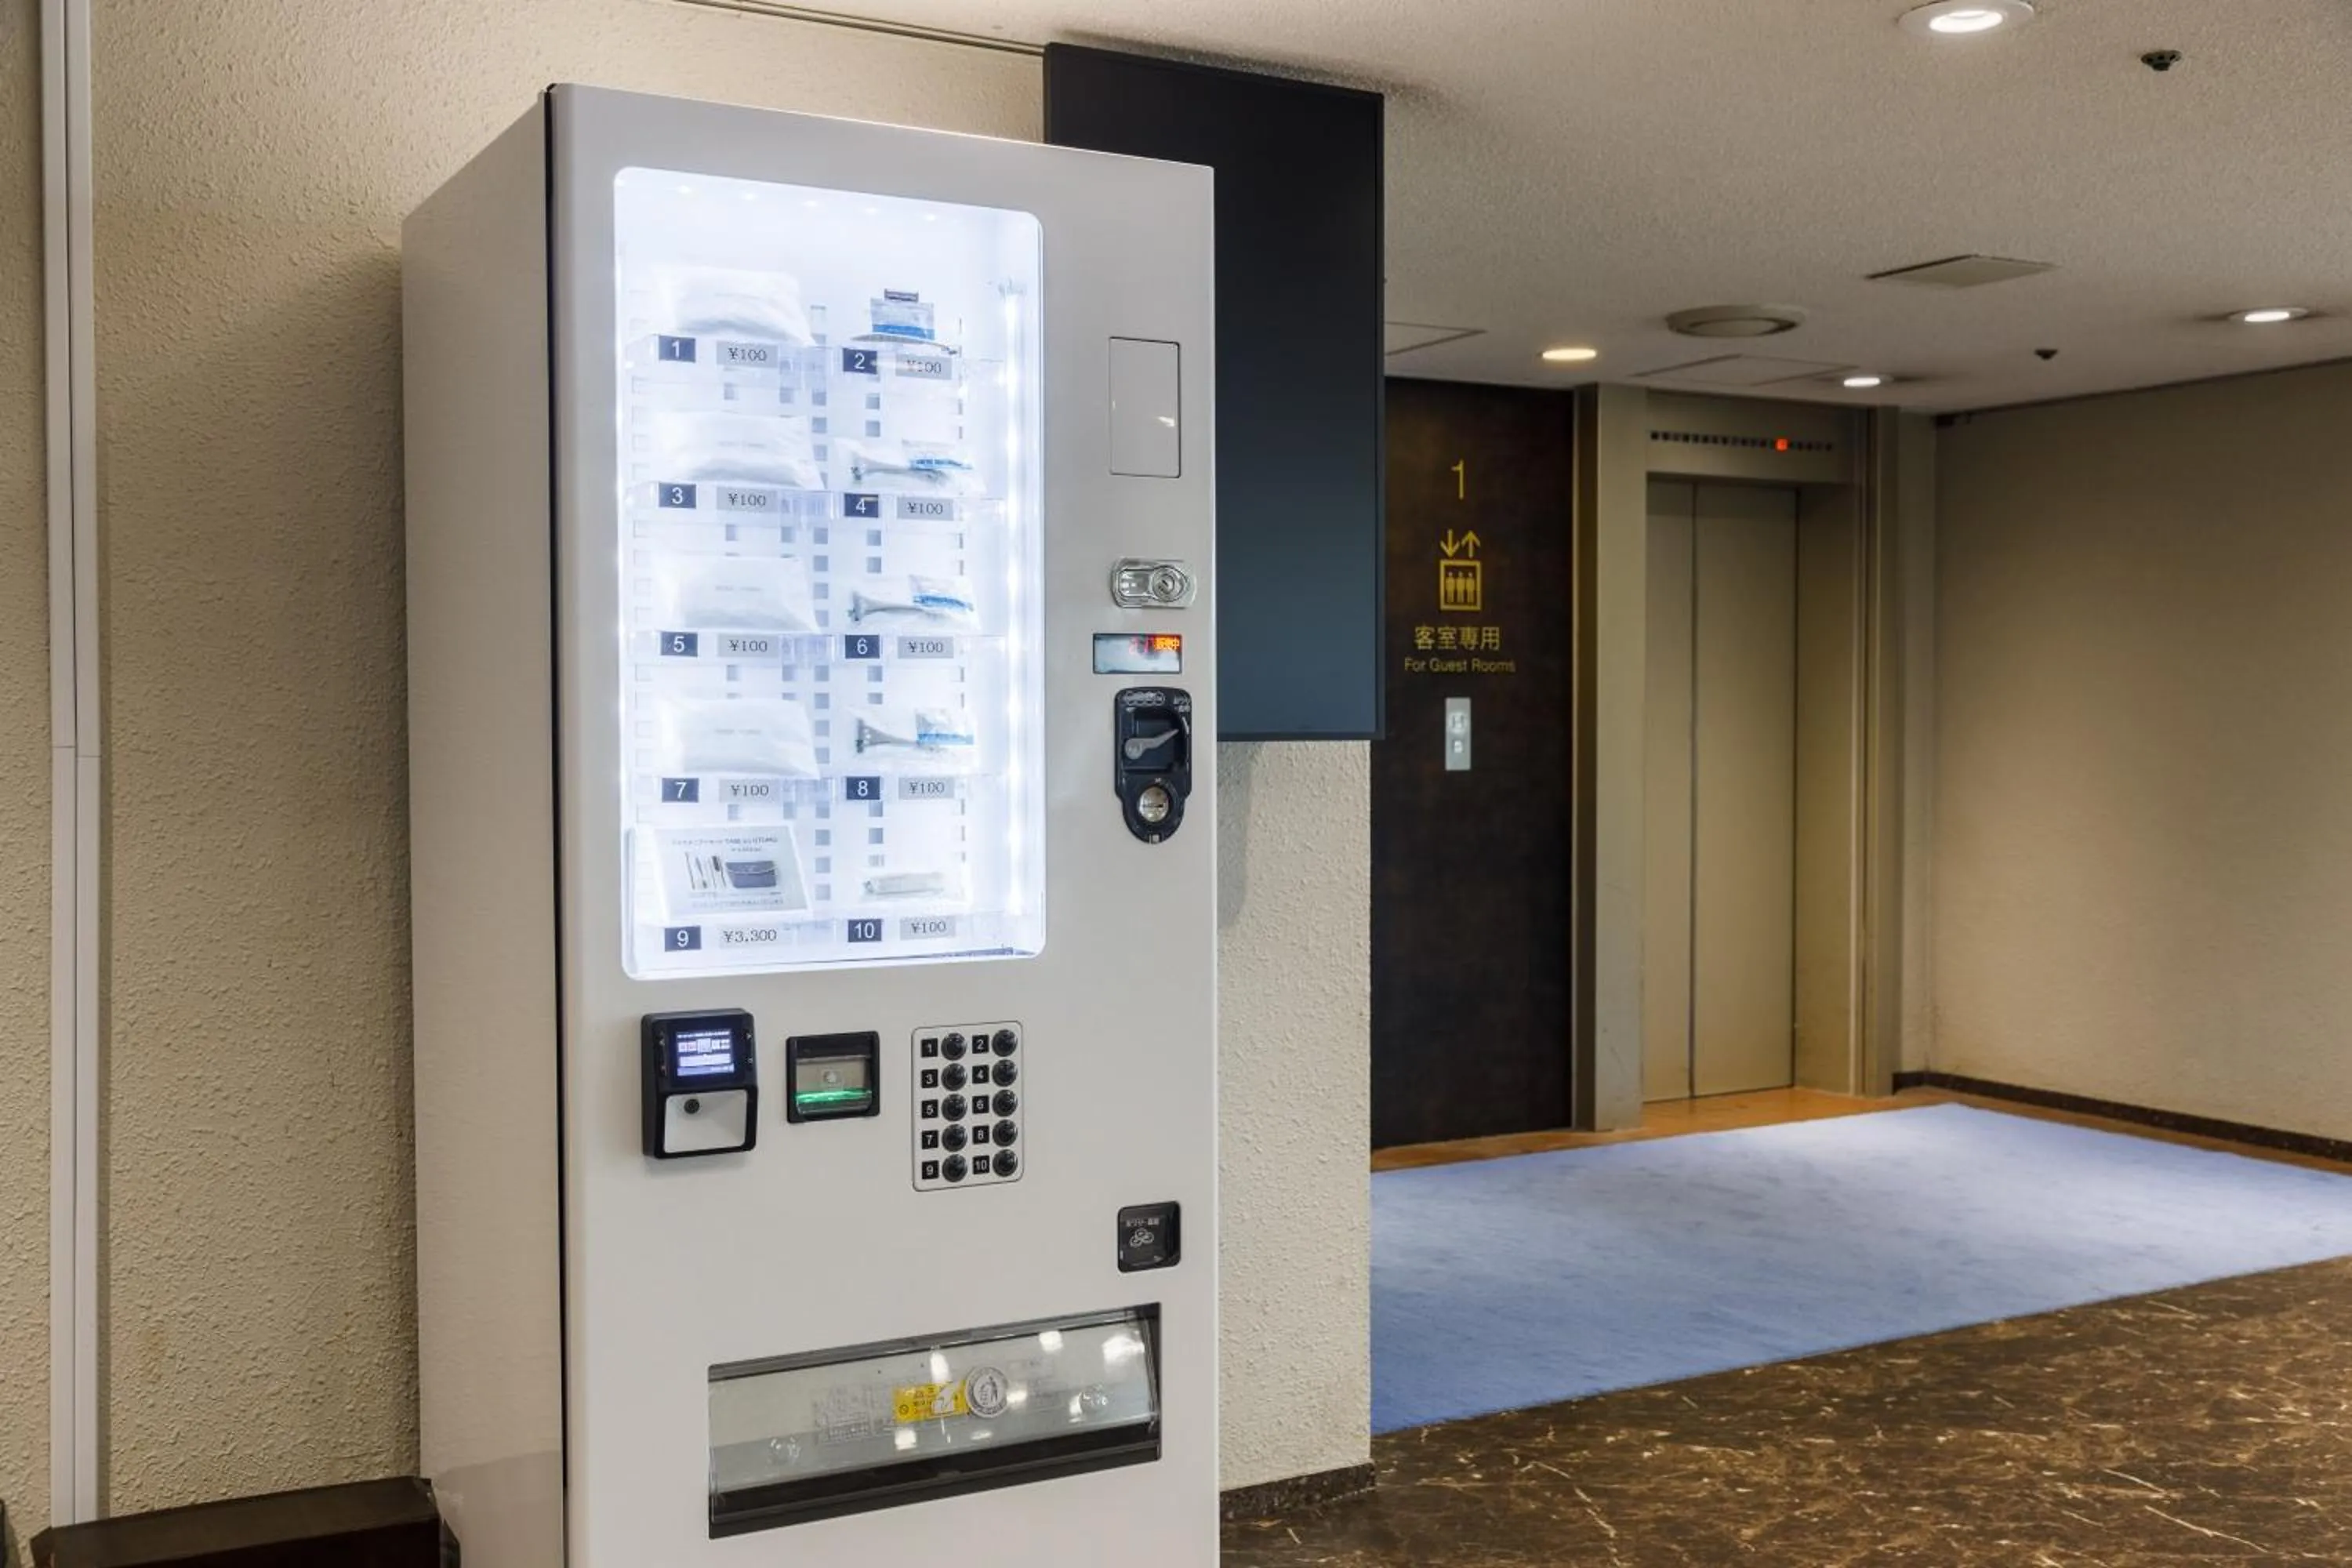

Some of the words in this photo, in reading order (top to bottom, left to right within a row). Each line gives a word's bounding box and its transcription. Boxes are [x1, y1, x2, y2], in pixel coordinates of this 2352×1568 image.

[671, 340, 681, 358] 1
[728, 347, 768, 361] ¥100
[854, 353, 866, 369] 2
[1450, 459, 1465, 499] 1
[671, 486, 684, 504] 3
[728, 492, 767, 506] ¥100
[855, 498, 866, 514] 4
[908, 502, 943, 515] ¥100
[673, 635, 684, 653] 5
[729, 639, 768, 653] ¥100
[856, 637, 868, 655] 6
[909, 641, 944, 653] ¥100
[1404, 657, 1426, 672] For
[1429, 658, 1468, 673] Guest
[1472, 659, 1516, 673] Rooms
[675, 782, 687, 798] 7
[731, 784, 769, 797] ¥100
[857, 780, 869, 797] 8
[909, 782, 945, 794] ¥100
[855, 922, 876, 938] 10
[911, 920, 946, 934] ¥100
[677, 930, 689, 948] 9
[978, 1039, 985, 1051] 2
[926, 1073, 933, 1084] 3
[977, 1069, 984, 1080] 4
[927, 1105, 934, 1116] 5
[977, 1100, 984, 1109] 6
[926, 1134, 933, 1145] 7
[978, 1130, 984, 1140] 8
[926, 1165, 934, 1176] 9
[975, 1160, 987, 1171] 10
